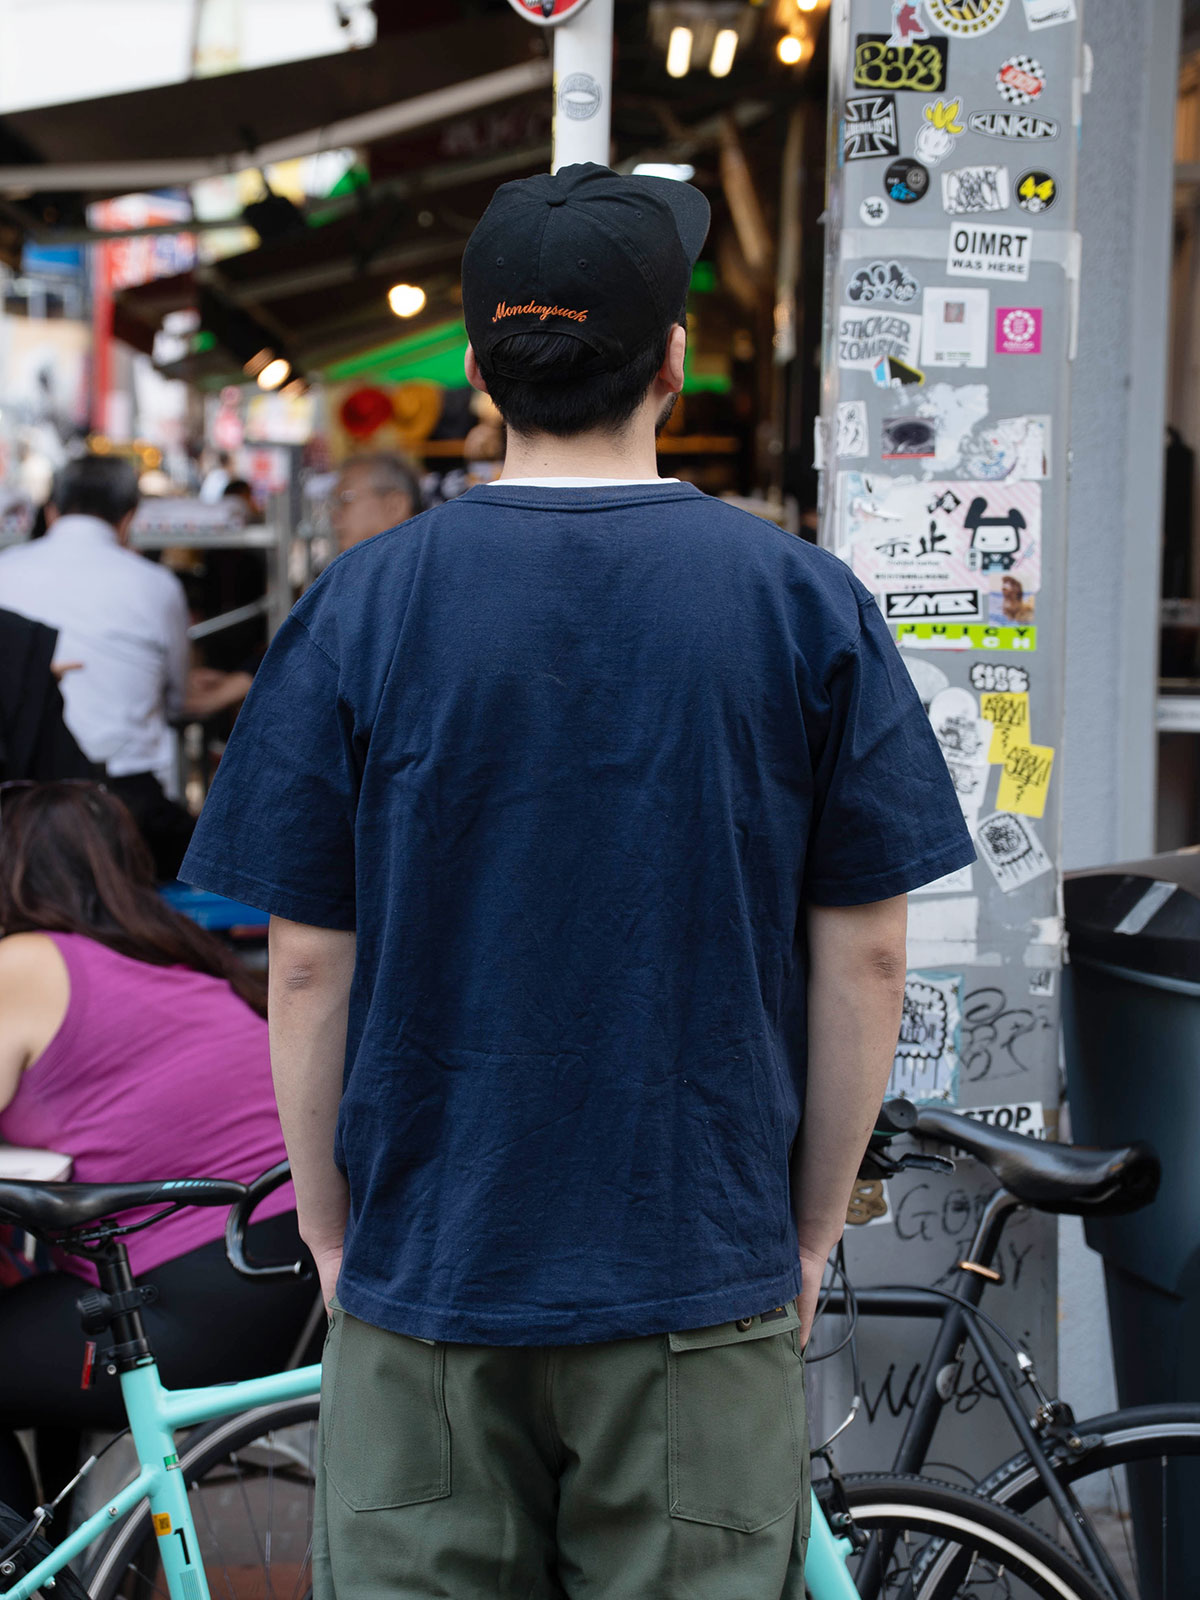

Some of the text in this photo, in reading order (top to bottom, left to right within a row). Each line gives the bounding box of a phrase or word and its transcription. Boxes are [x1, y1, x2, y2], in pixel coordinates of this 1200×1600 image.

[954, 230, 1028, 258] OIMRT
[951, 259, 1026, 275] WAS HERE
[492, 300, 589, 323] Mondaysuck
[840, 316, 911, 343] STICKER
[903, 625, 1028, 637] JUICY
